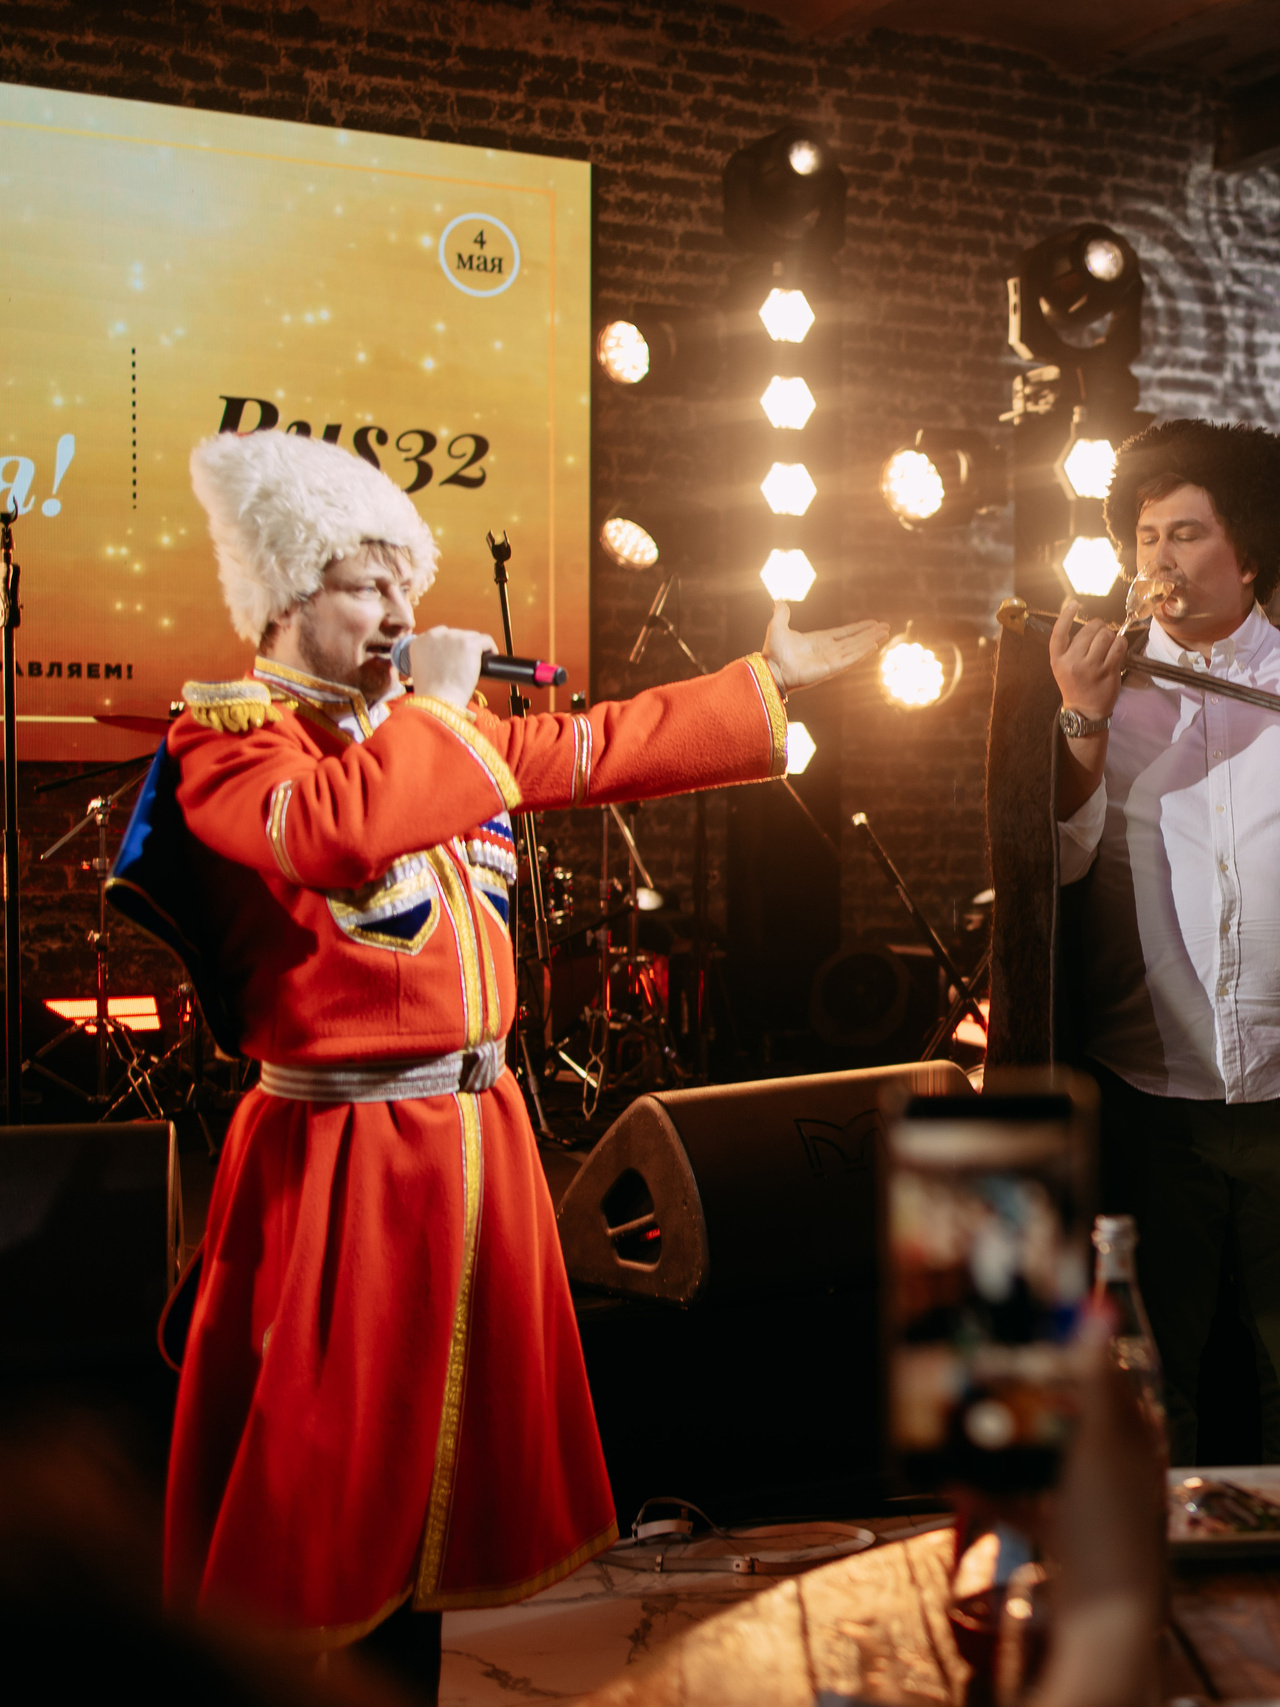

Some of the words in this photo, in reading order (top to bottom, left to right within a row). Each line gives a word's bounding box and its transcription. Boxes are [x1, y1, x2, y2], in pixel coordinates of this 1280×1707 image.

[473, 229, 487, 250] 4
[456, 252, 504, 275] мая
[0, 661, 133, 680] АВЛЯЕМ!
